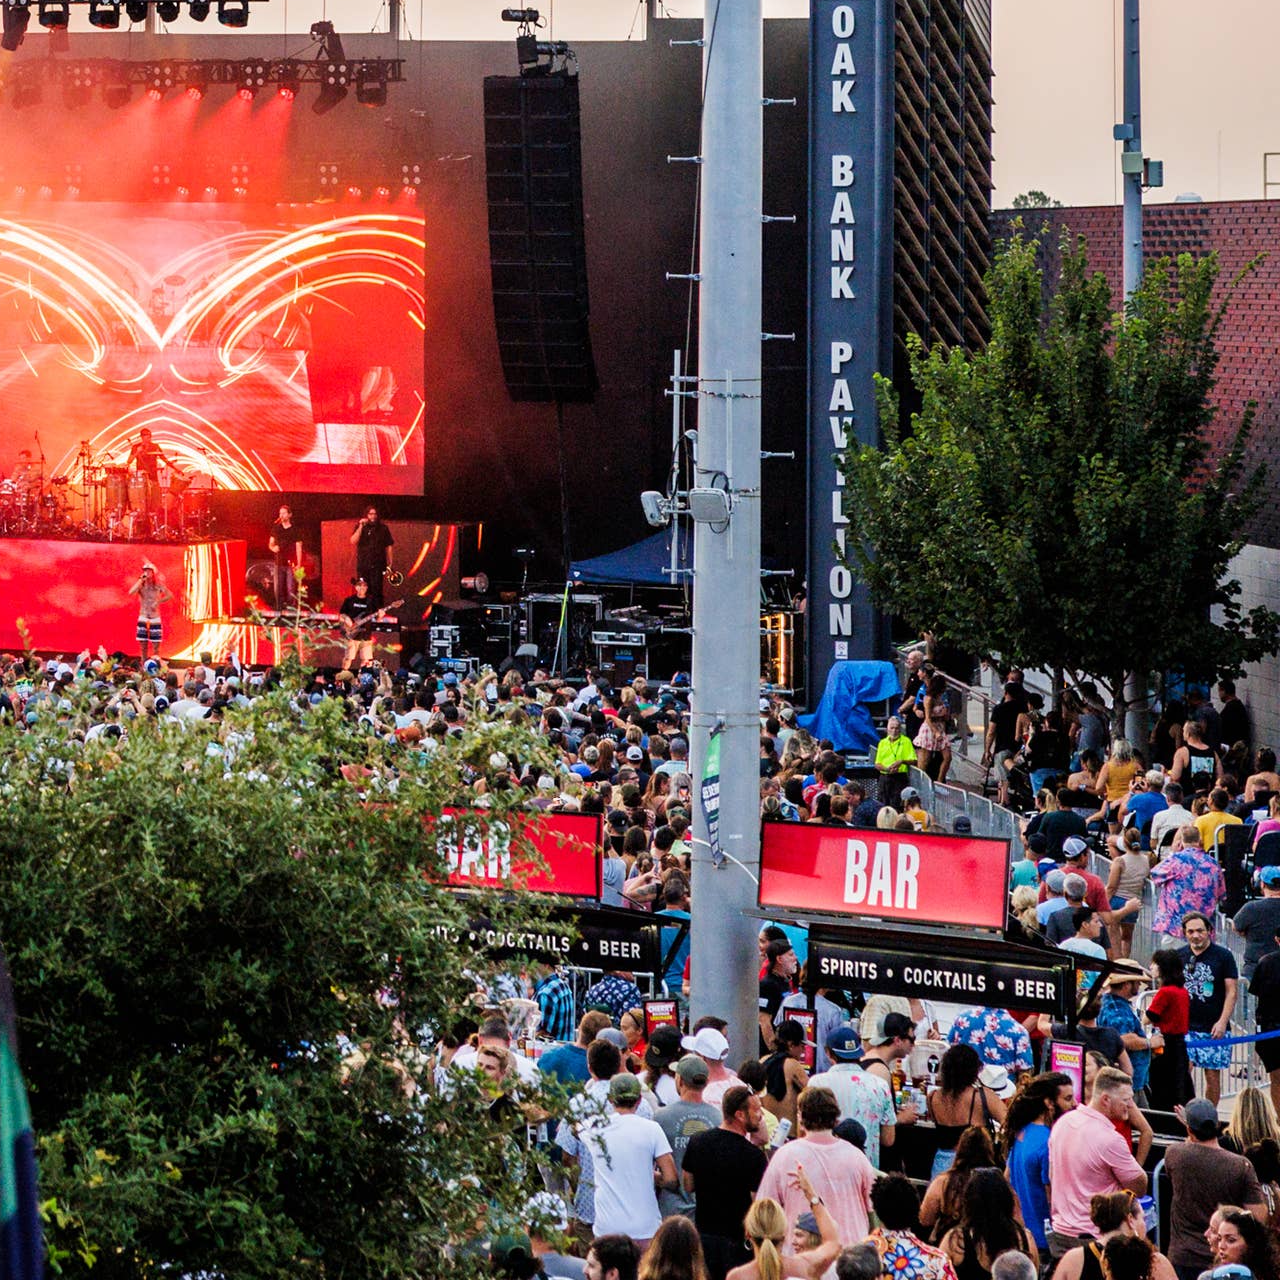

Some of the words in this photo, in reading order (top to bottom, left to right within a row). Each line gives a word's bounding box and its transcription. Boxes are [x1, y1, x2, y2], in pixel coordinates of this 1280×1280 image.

[830, 5, 857, 113] OAK
[829, 154, 856, 300] BANK
[828, 341, 855, 637] PAVILION
[843, 838, 920, 910] BAR
[485, 929, 571, 953] COCKTAILS
[599, 939, 641, 959] BEER
[820, 957, 878, 980] SPIRITS
[903, 966, 986, 992] COCKTAILS
[1014, 978, 1057, 1001] BEER
